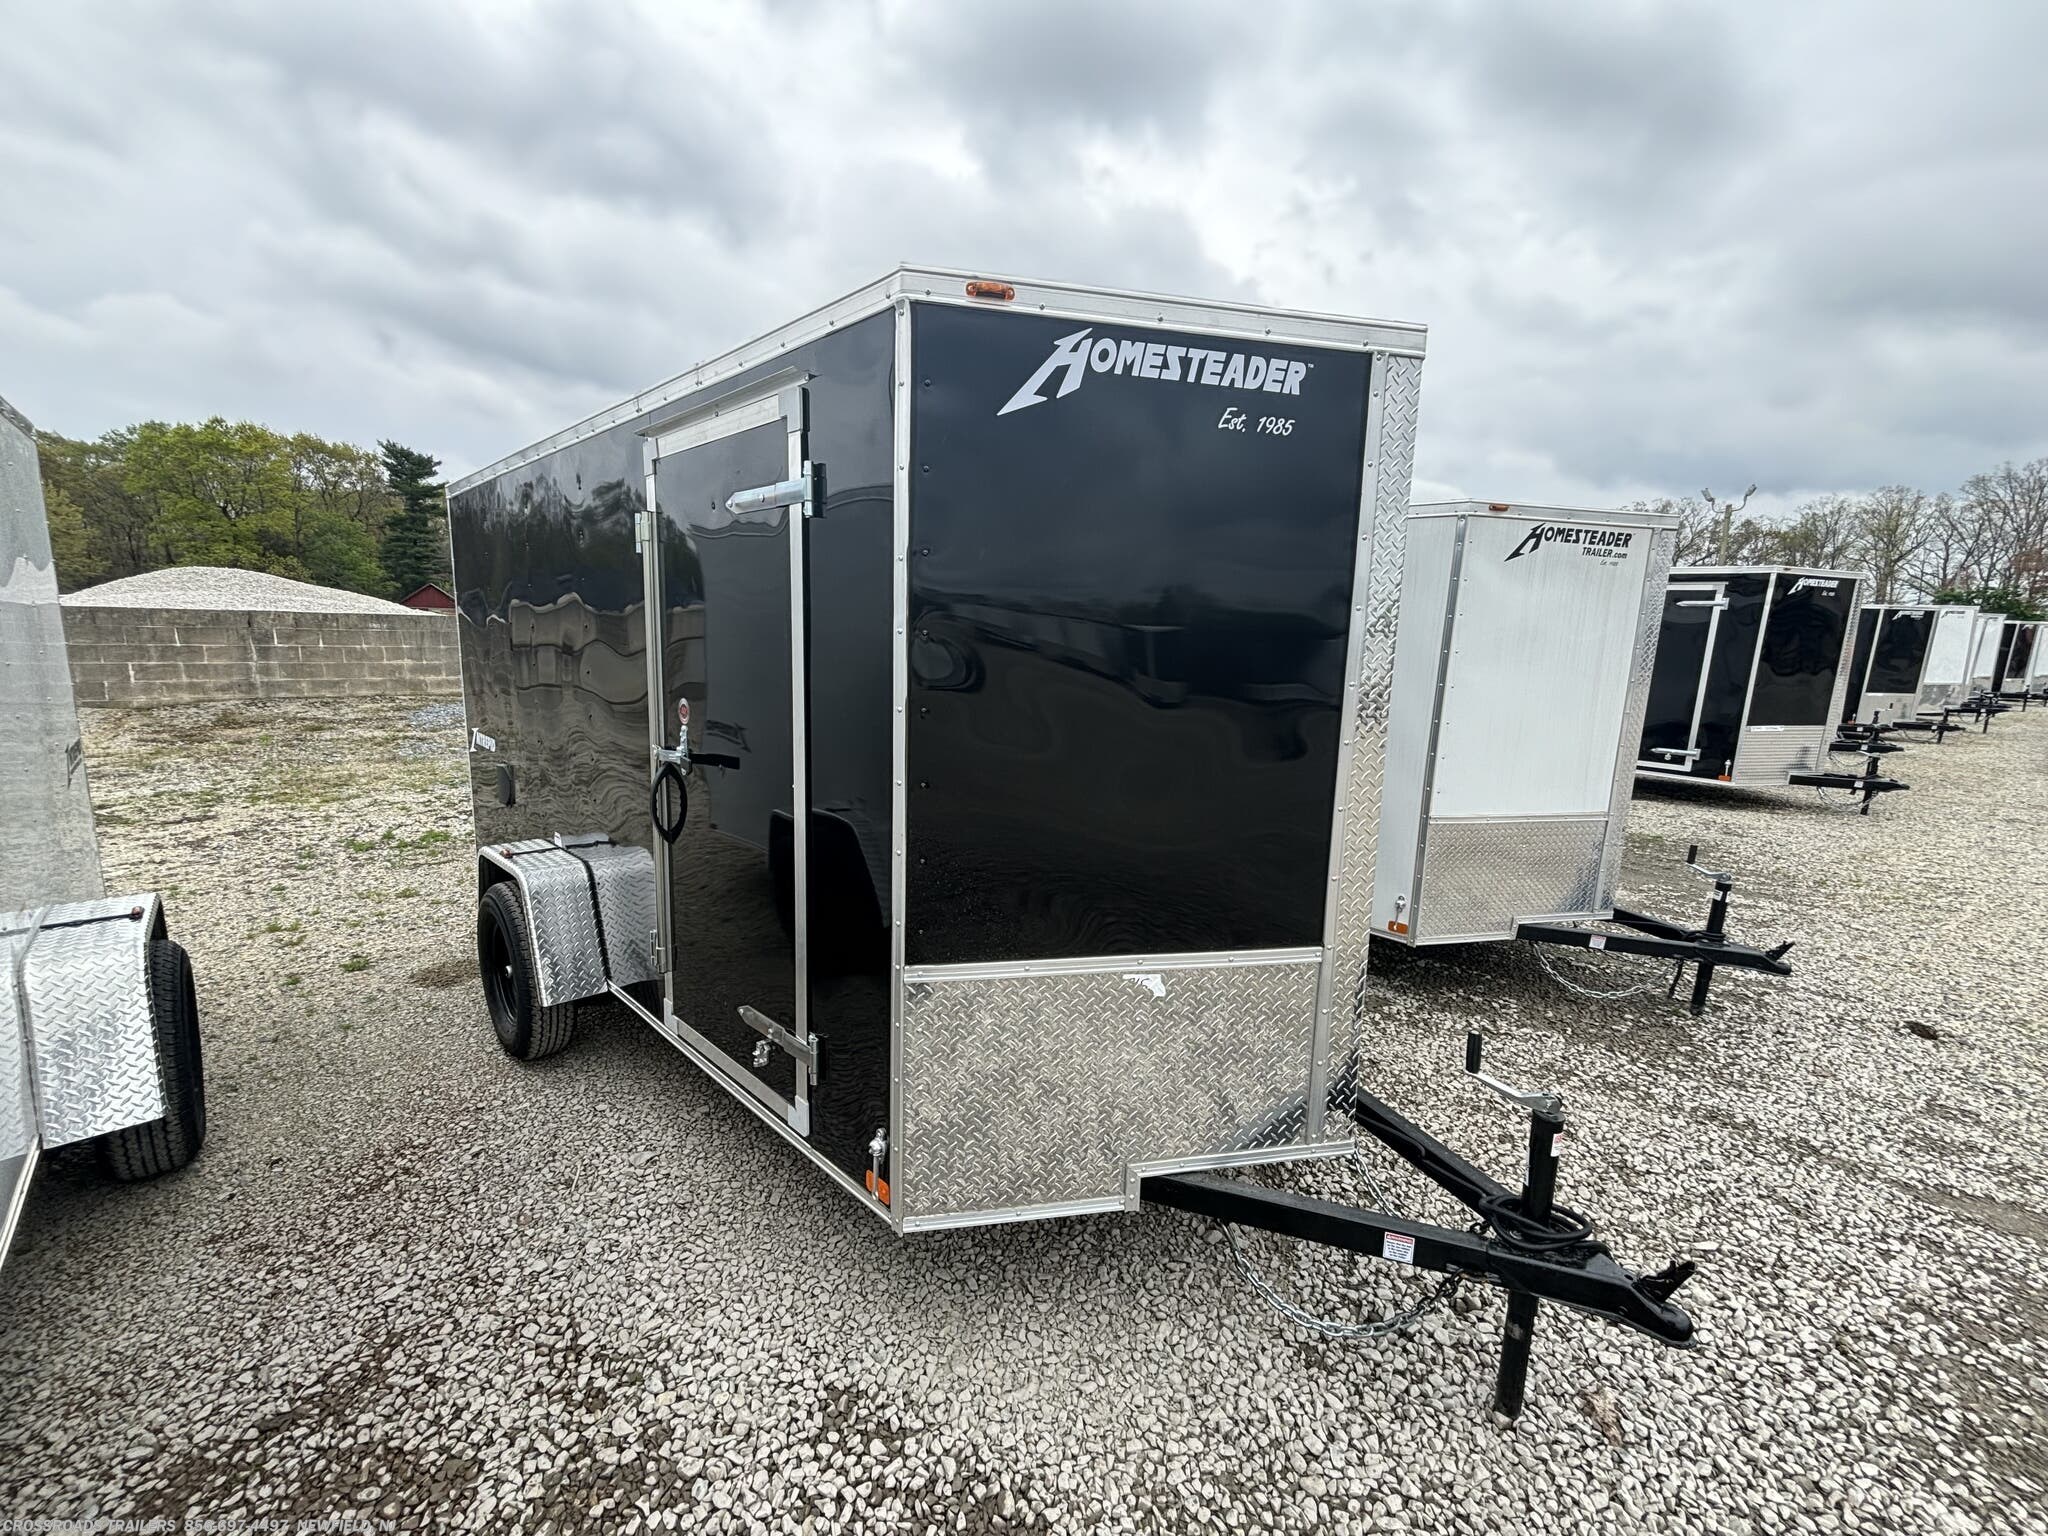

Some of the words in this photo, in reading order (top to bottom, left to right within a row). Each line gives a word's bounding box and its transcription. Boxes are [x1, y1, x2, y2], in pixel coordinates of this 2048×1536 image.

[998, 328, 1306, 415] HOMESTEADER
[1218, 407, 1247, 432] Est.
[1257, 416, 1295, 435] 1985
[1504, 523, 1632, 562] HOMESTEADER
